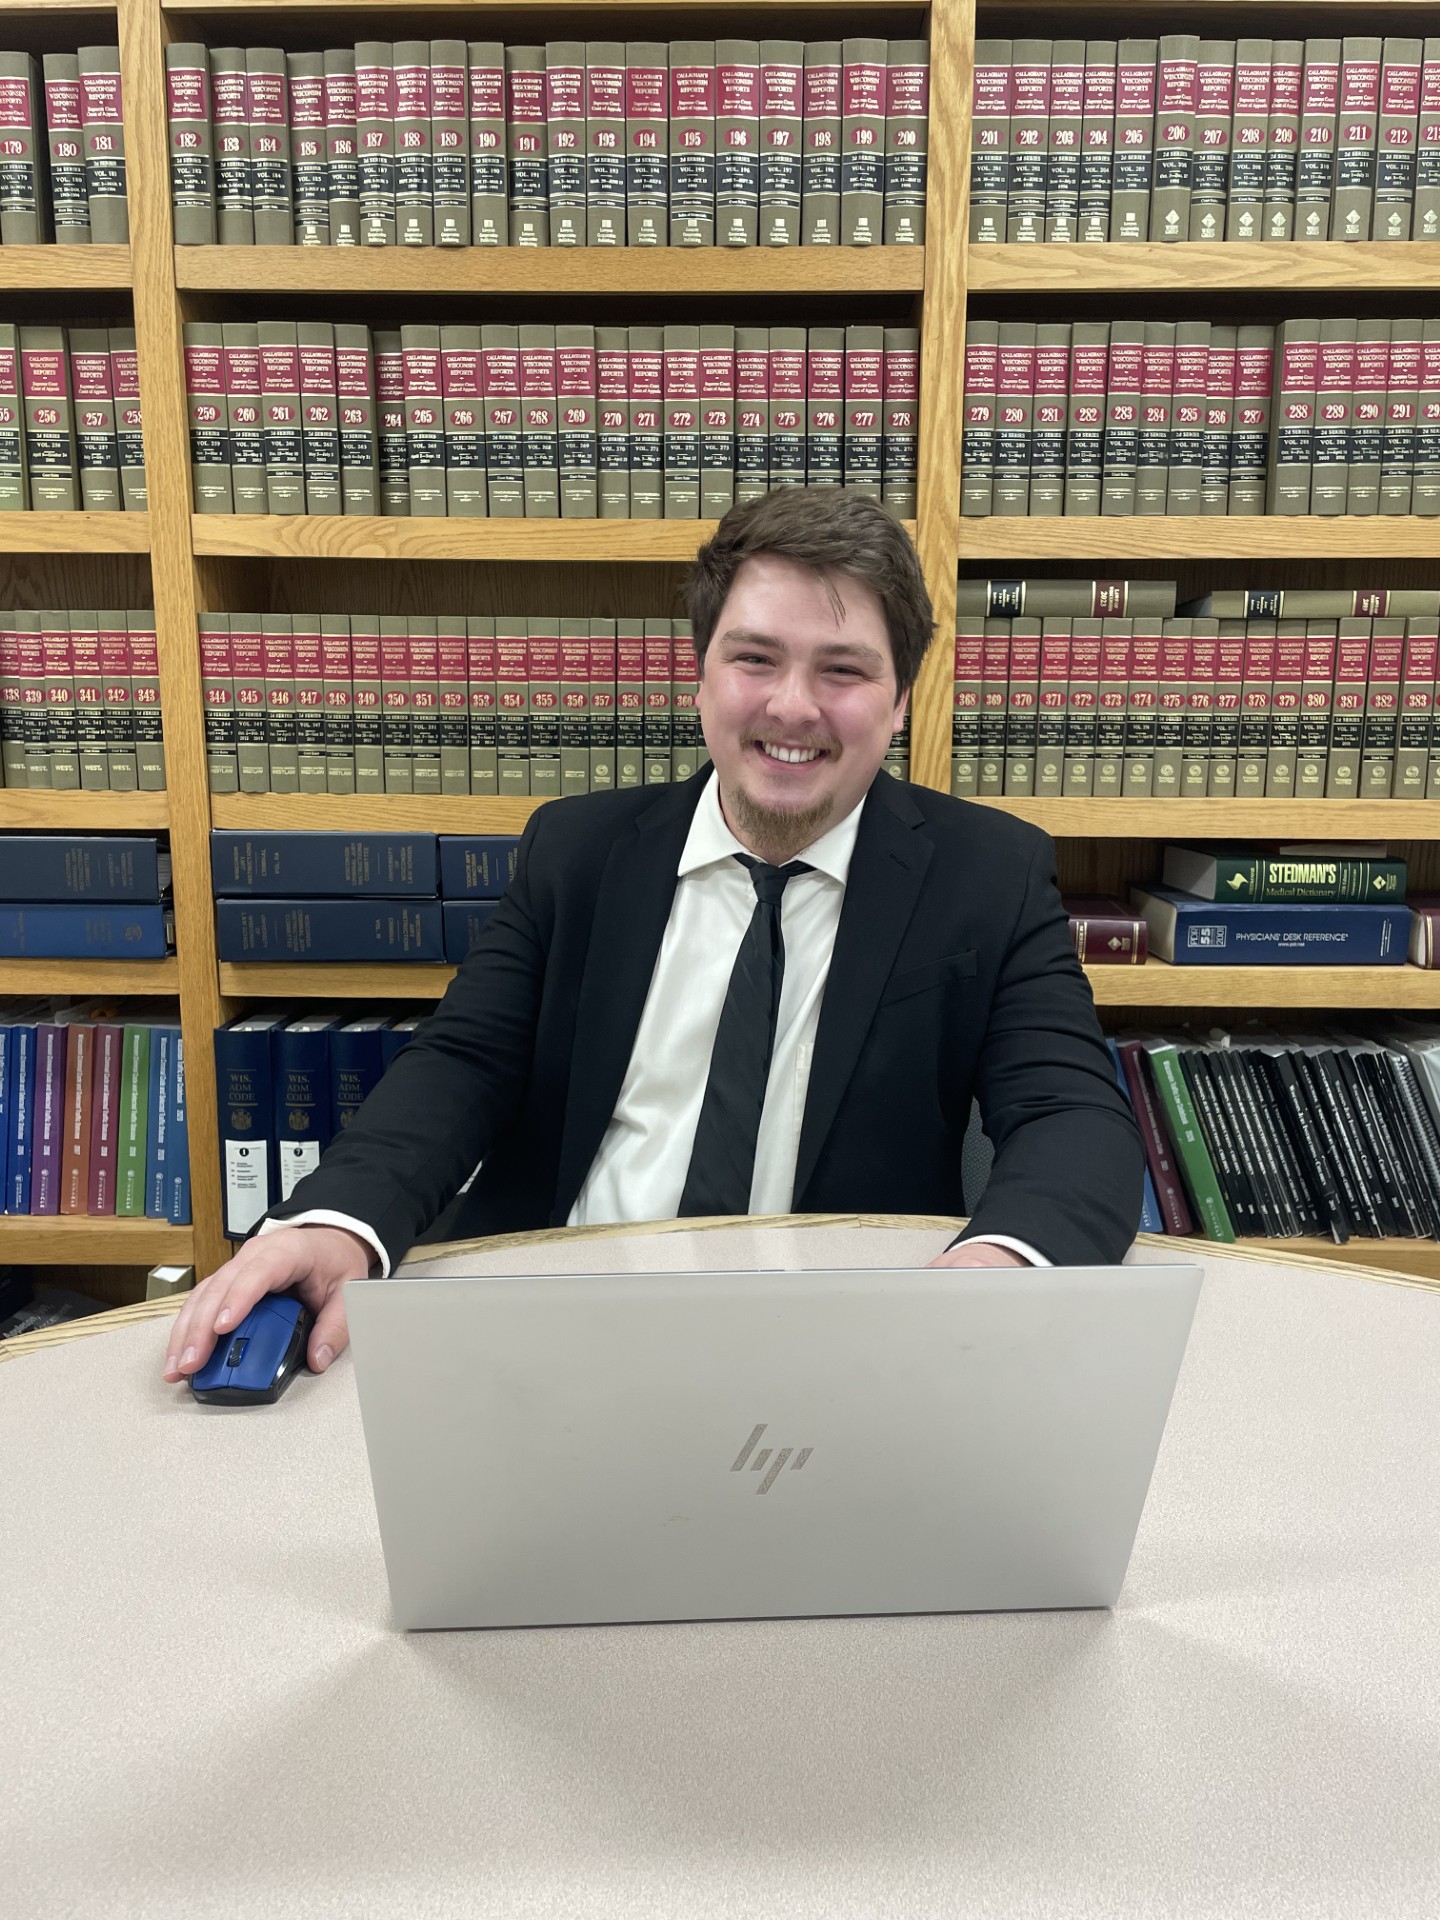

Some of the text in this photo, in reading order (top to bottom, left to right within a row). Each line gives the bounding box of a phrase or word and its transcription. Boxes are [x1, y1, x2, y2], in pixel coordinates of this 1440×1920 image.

[366, 132, 383, 147] 187
[403, 132, 421, 147] 188
[440, 132, 457, 147] 189
[598, 132, 615, 147] 193
[685, 132, 701, 146] 195
[730, 130, 747, 146] 196
[773, 130, 790, 146] 197
[815, 131, 831, 147] 198
[856, 129, 873, 145] 199
[897, 130, 916, 145] 200
[981, 130, 998, 145] 201
[1020, 130, 1039, 145] 202
[1056, 130, 1074, 145] 203
[1089, 130, 1108, 145] 204
[1125, 129, 1143, 144] 205
[1167, 125, 1186, 140] 206
[1204, 129, 1222, 144] 207
[1241, 128, 1260, 143] 208
[1275, 128, 1292, 143] 209
[1310, 128, 1328, 142] 210
[1349, 126, 1367, 141] 211
[1390, 129, 1408, 144] 212
[4, 140, 22, 154] 179
[95, 136, 113, 150] 181
[180, 133, 197, 148] 182
[223, 137, 240, 152] 183
[259, 138, 276, 152] 184
[334, 140, 352, 154] 186
[479, 133, 496, 148] 190
[519, 137, 535, 151] 191
[558, 133, 575, 147] 192
[639, 133, 656, 147] 194
[58, 143, 77, 157] 180
[300, 141, 317, 156] 185
[38, 409, 56, 423] 256
[197, 406, 216, 420] 259
[237, 408, 255, 422] 260
[272, 406, 289, 420] 261
[310, 407, 328, 421] 262
[344, 409, 362, 423] 263
[414, 409, 433, 423] 265
[454, 410, 472, 424] 266
[494, 410, 513, 424] 267
[530, 410, 548, 424] 268
[567, 409, 586, 423] 269
[708, 411, 726, 425] 273
[971, 407, 989, 421] 279
[1005, 408, 1023, 422] 280
[1041, 408, 1059, 422] 281
[1079, 407, 1097, 422] 282
[1114, 406, 1133, 420] 283
[1147, 407, 1164, 422] 284
[1180, 407, 1198, 422] 285
[1208, 410, 1226, 424] 286
[1243, 409, 1259, 424] 287
[1289, 404, 1308, 419] 288
[1326, 404, 1344, 419] 289
[1360, 404, 1379, 418] 290
[1392, 404, 1410, 418] 291
[86, 412, 103, 426] 257
[604, 412, 622, 426] 270
[638, 412, 655, 426] 271
[674, 412, 691, 426] 272
[743, 413, 760, 427] 274
[780, 412, 796, 425] 275
[816, 412, 835, 426] 276
[857, 412, 874, 426] 277
[892, 412, 910, 426] 278
[26, 690, 42, 703] 339
[52, 690, 68, 702] 340
[80, 689, 96, 701] 341
[108, 689, 124, 701] 342
[138, 689, 154, 701] 343
[209, 690, 225, 702] 344
[242, 690, 258, 703] 345
[272, 691, 288, 703] 346
[300, 691, 316, 703] 347
[330, 693, 346, 705] 348
[358, 693, 374, 705] 349
[388, 693, 404, 705] 350
[416, 693, 432, 705] 351
[445, 693, 461, 705] 352
[474, 694, 490, 706] 353
[504, 693, 520, 705] 354
[536, 693, 552, 705] 355
[622, 694, 638, 706] 358
[960, 693, 976, 705] 368
[1016, 694, 1032, 706] 370
[1045, 694, 1061, 706] 371
[1075, 694, 1091, 706] 372
[1106, 694, 1122, 706] 373
[1134, 694, 1150, 706] 374
[1164, 694, 1180, 706] 375
[1192, 695, 1208, 708] 376
[1220, 695, 1236, 707] 377
[1249, 694, 1265, 707] 378
[1279, 694, 1295, 707] 379
[1308, 694, 1324, 706] 380
[1342, 695, 1358, 708] 381
[1376, 695, 1392, 707] 382
[1410, 694, 1426, 707] 383
[1269, 863, 1336, 884] STEDMAN'S
[1266, 888, 1336, 898] Medical Dictionary
[1200, 928, 1210, 944] 55
[1236, 933, 1281, 943] PHYSICIANS'
[1283, 933, 1302, 942] DESK
[230, 1074, 252, 1083] WIS.
[288, 1074, 310, 1083] WIS.
[339, 1074, 361, 1082] WIS.
[228, 1092, 255, 1100] CODE
[286, 1092, 313, 1102] CODE
[338, 1092, 364, 1100] CODE
[729, 1424, 814, 1496] hp
